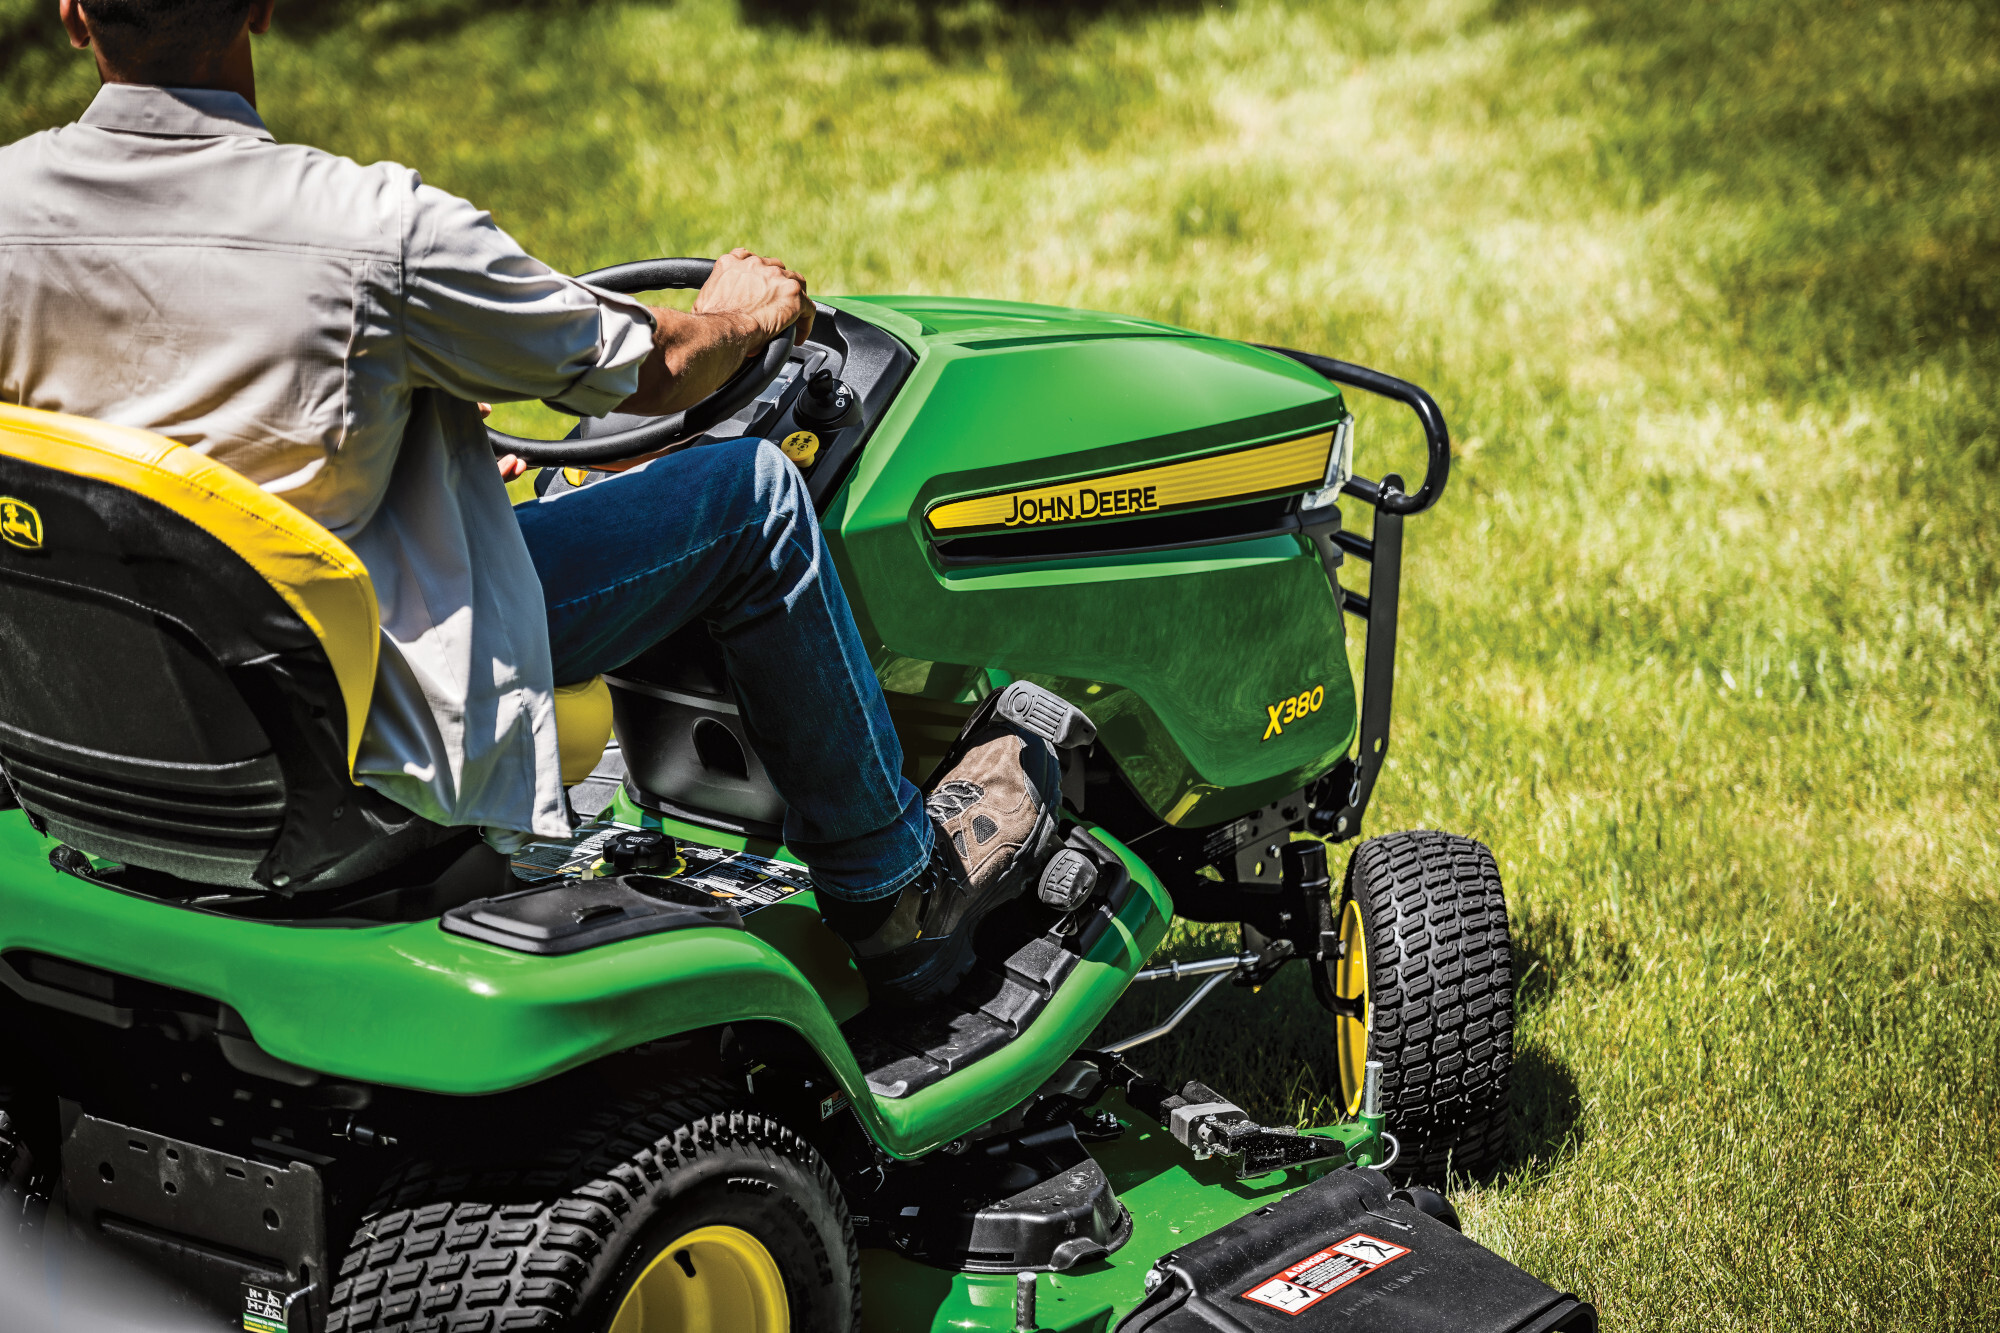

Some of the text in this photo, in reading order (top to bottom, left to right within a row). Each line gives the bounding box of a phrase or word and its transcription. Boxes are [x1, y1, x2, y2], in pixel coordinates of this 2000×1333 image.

[1005, 486, 1158, 525] JOHN DEERE
[1262, 685, 1325, 741] X380
[1292, 1252, 1332, 1273] DANGER
